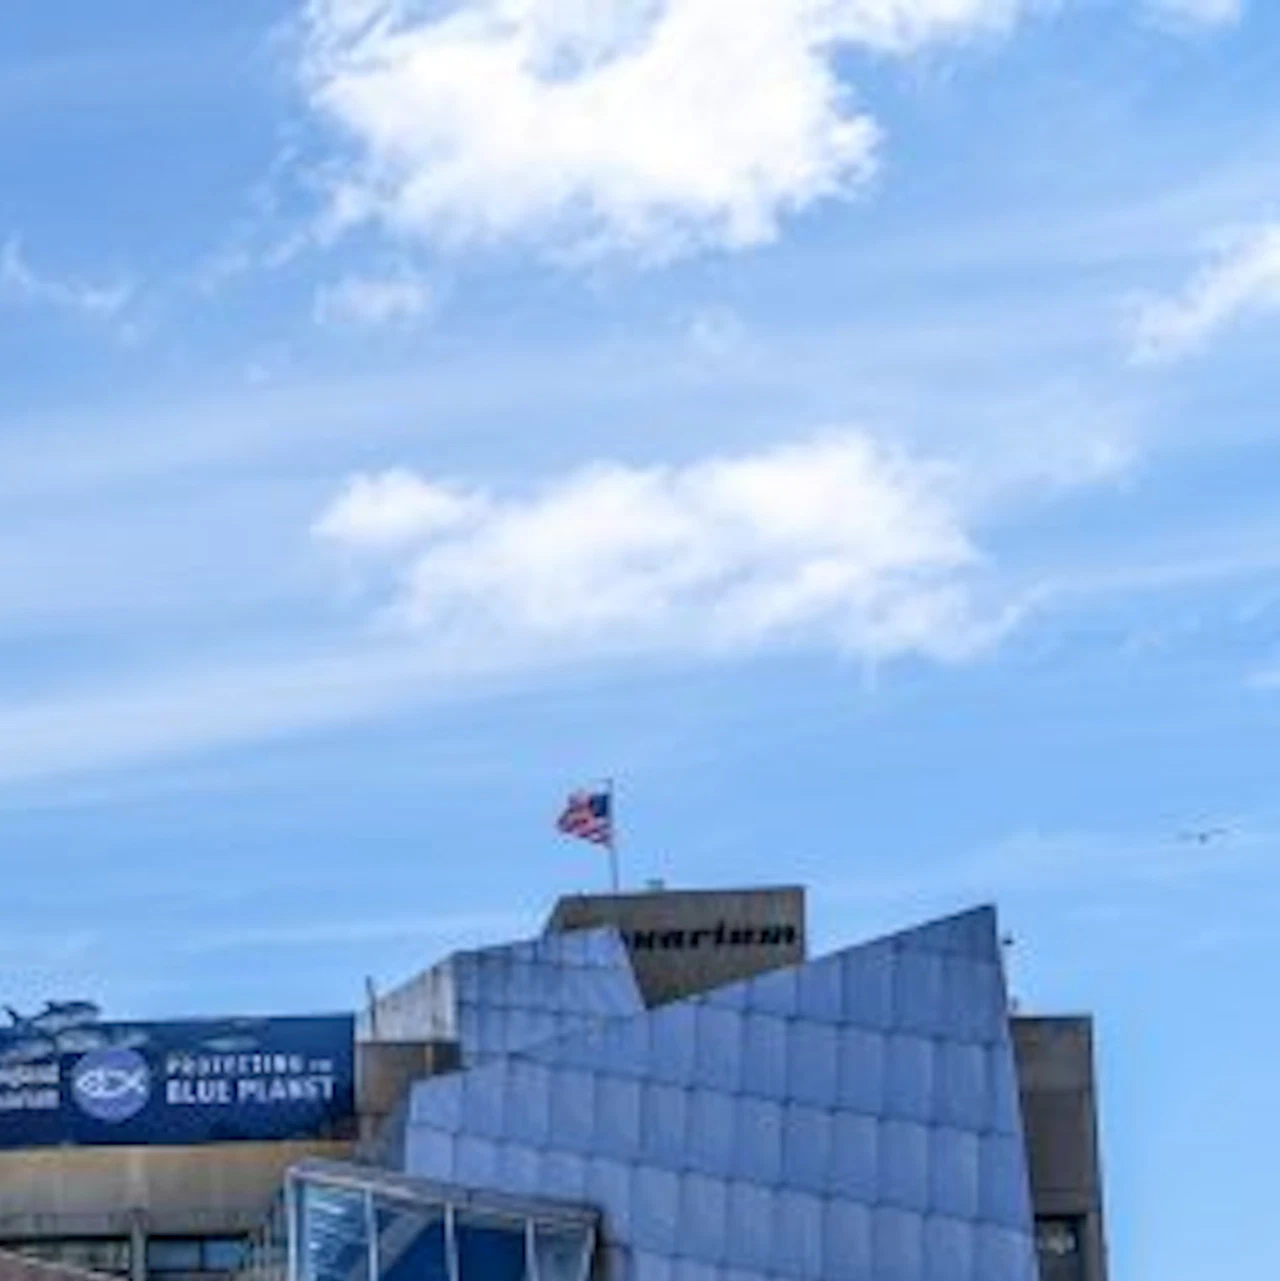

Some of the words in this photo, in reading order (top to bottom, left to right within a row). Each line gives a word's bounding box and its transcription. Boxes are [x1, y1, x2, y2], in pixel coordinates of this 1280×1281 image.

[165, 1052, 303, 1077] PROTECTING
[166, 1079, 233, 1104] BLUE
[236, 1074, 333, 1103] PLANET
